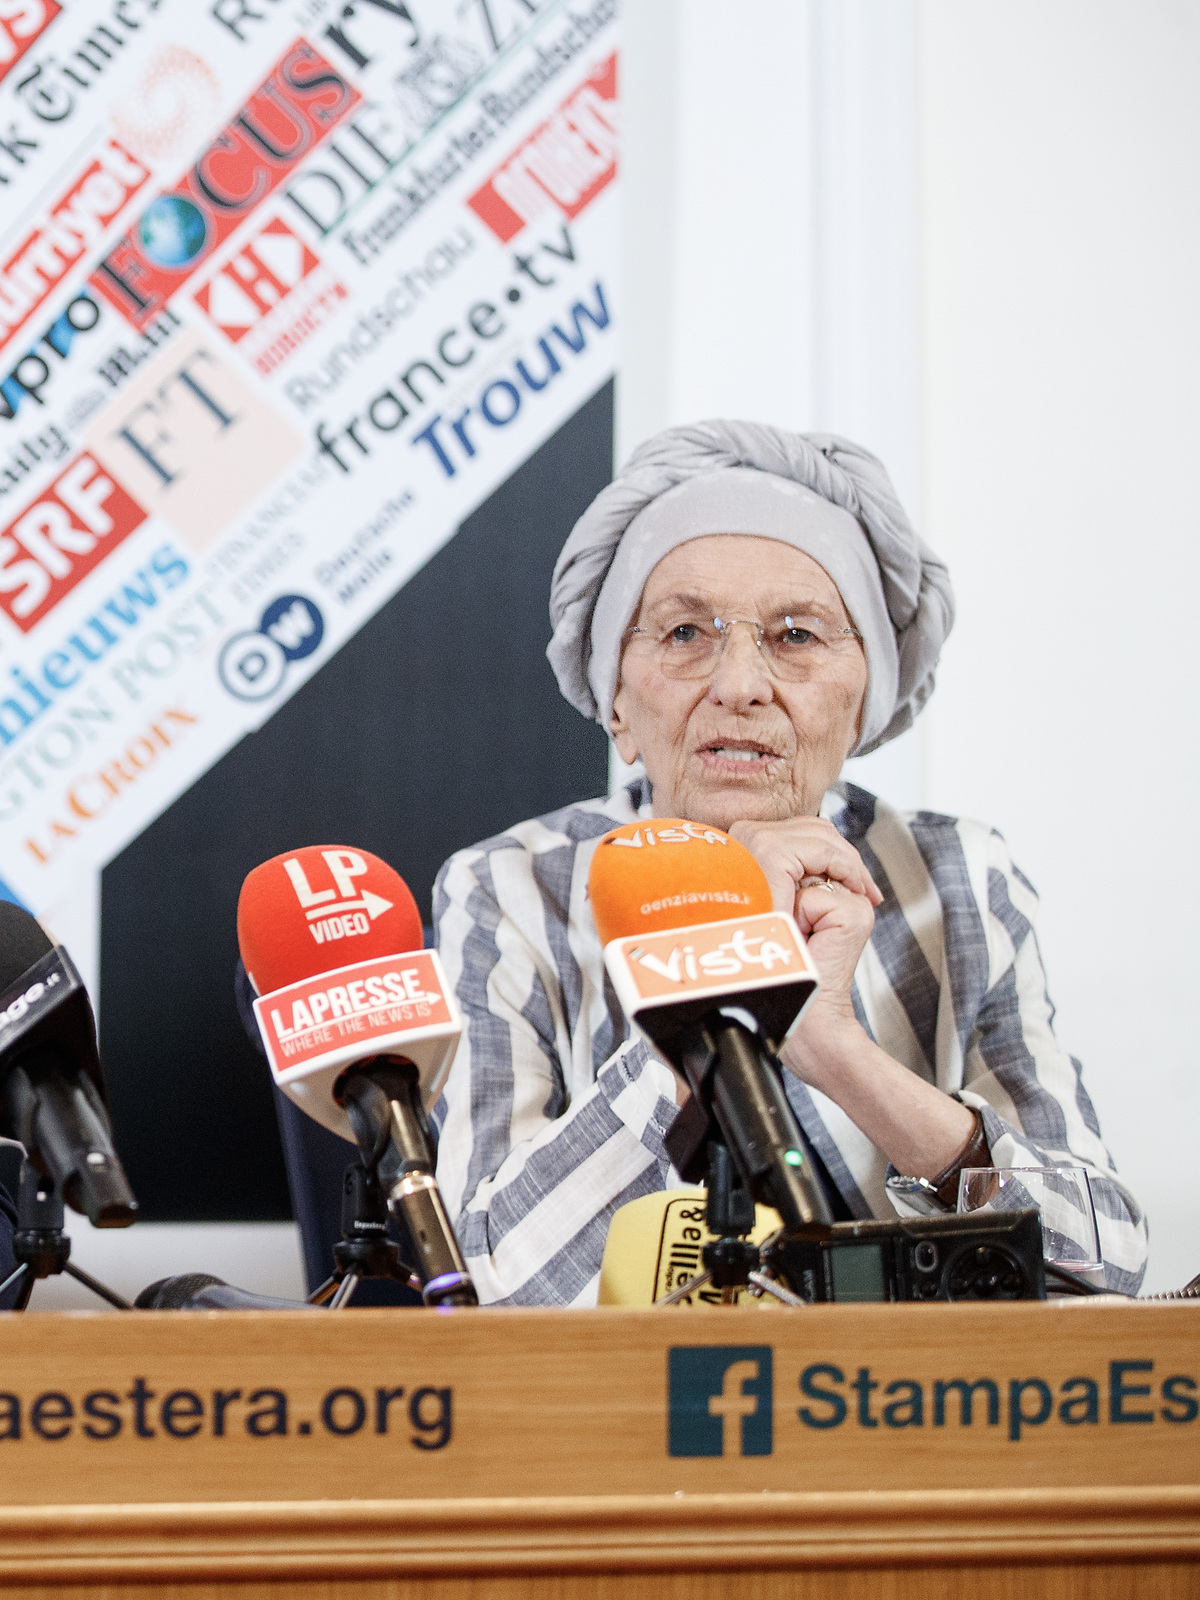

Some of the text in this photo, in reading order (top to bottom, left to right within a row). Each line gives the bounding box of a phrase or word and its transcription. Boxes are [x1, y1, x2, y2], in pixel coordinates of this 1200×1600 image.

[411, 278, 611, 478] Trouw
[112, 345, 242, 490] FT
[283, 850, 369, 908] LP
[308, 912, 371, 945] VIDEO
[269, 968, 427, 1040] LAPRESSE
[278, 1001, 434, 1058] WHERE THE NEWS IS
[797, 1359, 1200, 1442] StampaEs
